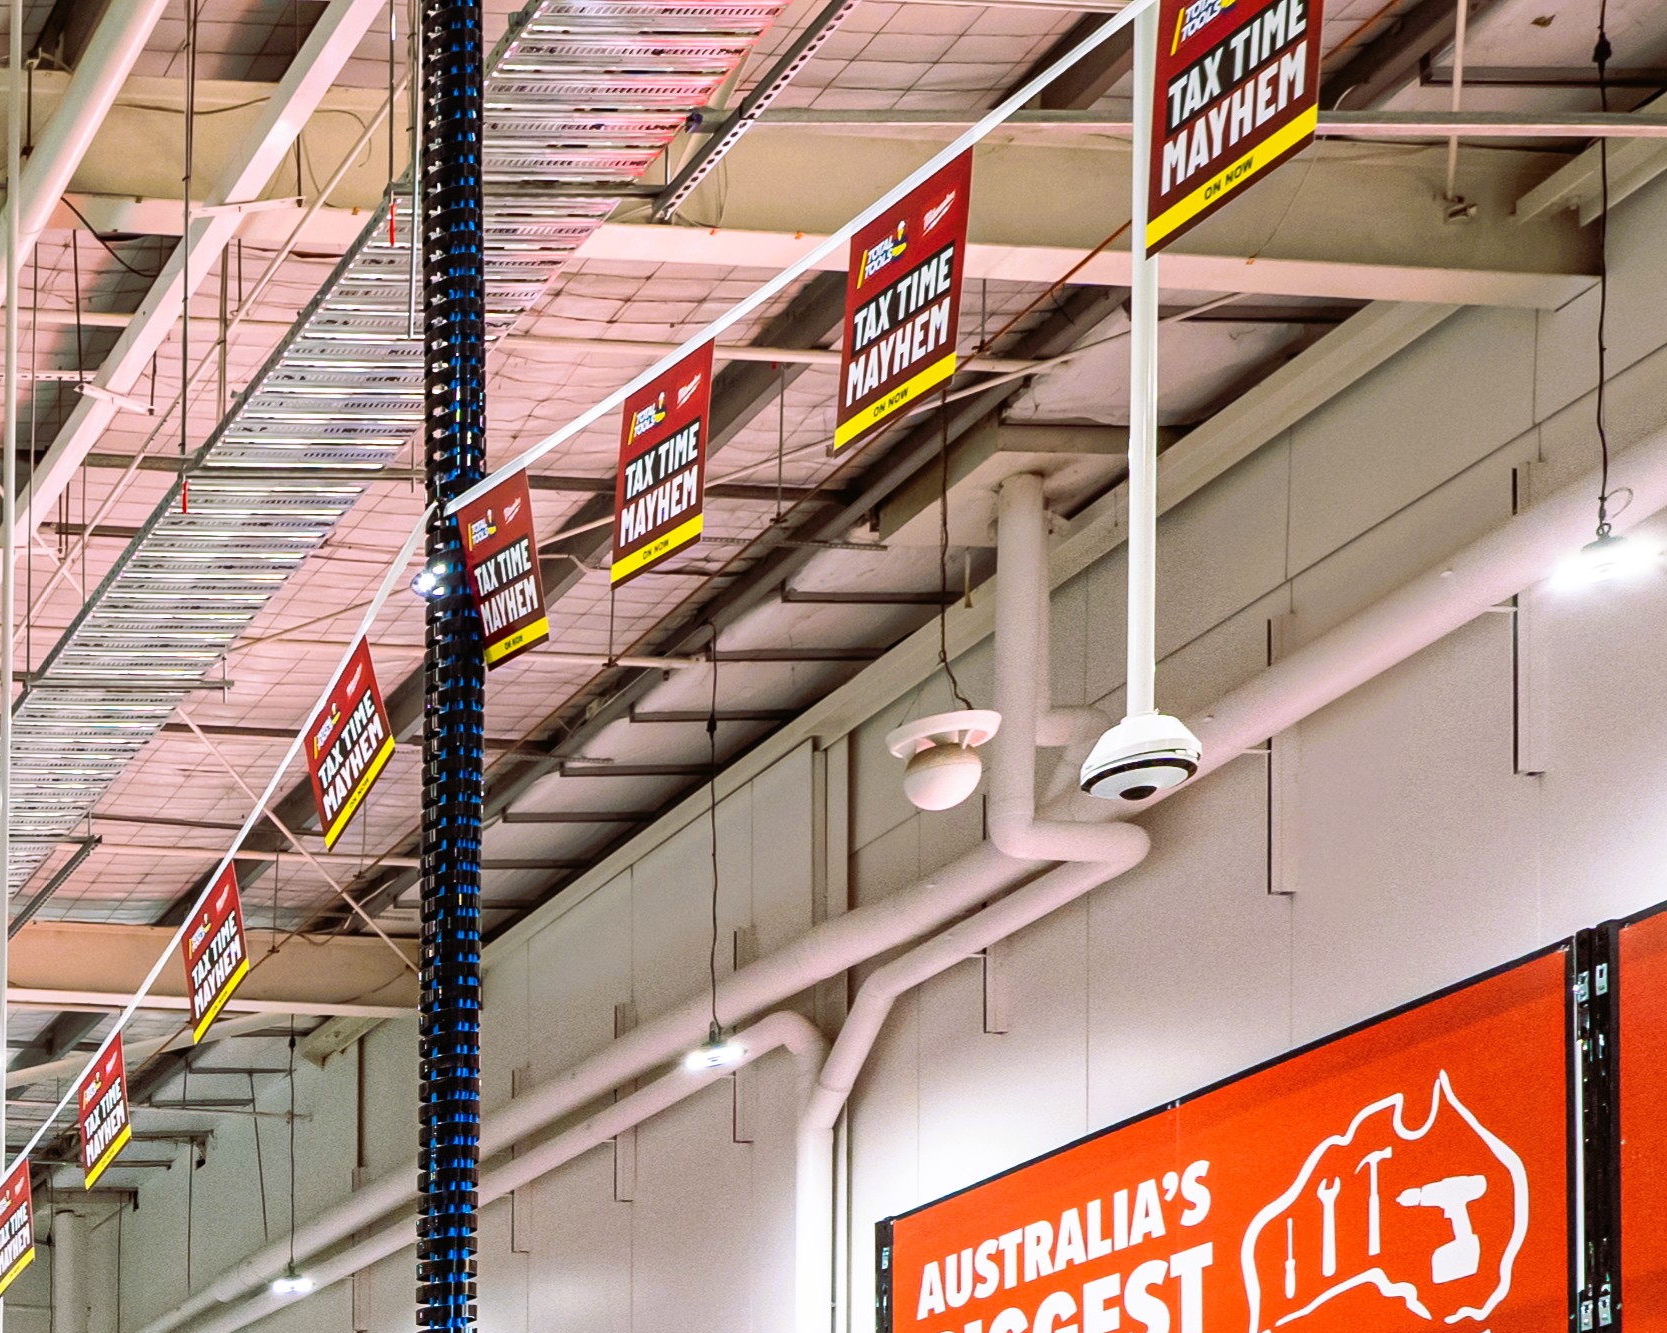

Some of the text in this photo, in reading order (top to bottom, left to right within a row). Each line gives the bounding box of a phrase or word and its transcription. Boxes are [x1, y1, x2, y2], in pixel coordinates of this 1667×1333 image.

[1181, 3, 1221, 43] TOOLS
[1168, 0, 1307, 129] TAX TIME
[1161, 40, 1307, 197] MAYHEM
[1204, 156, 1254, 201] ON NOW
[865, 248, 893, 280] TOOLS
[868, 235, 894, 263] TOTAL
[854, 247, 954, 351] TAX TIME
[846, 296, 951, 408] MAYHEM
[873, 386, 909, 418] ON NOW
[626, 422, 700, 500] TAX TIME
[620, 465, 698, 548] MAYHEM
[474, 538, 531, 597] TAX TIME
[479, 575, 538, 637] MAYHEM
[317, 690, 375, 790] TAX TIME
[323, 712, 384, 822] MAYHEM
[10, 1201, 28, 1235] TIME
[916, 1159, 1213, 1322] AUSTRALIA'S
